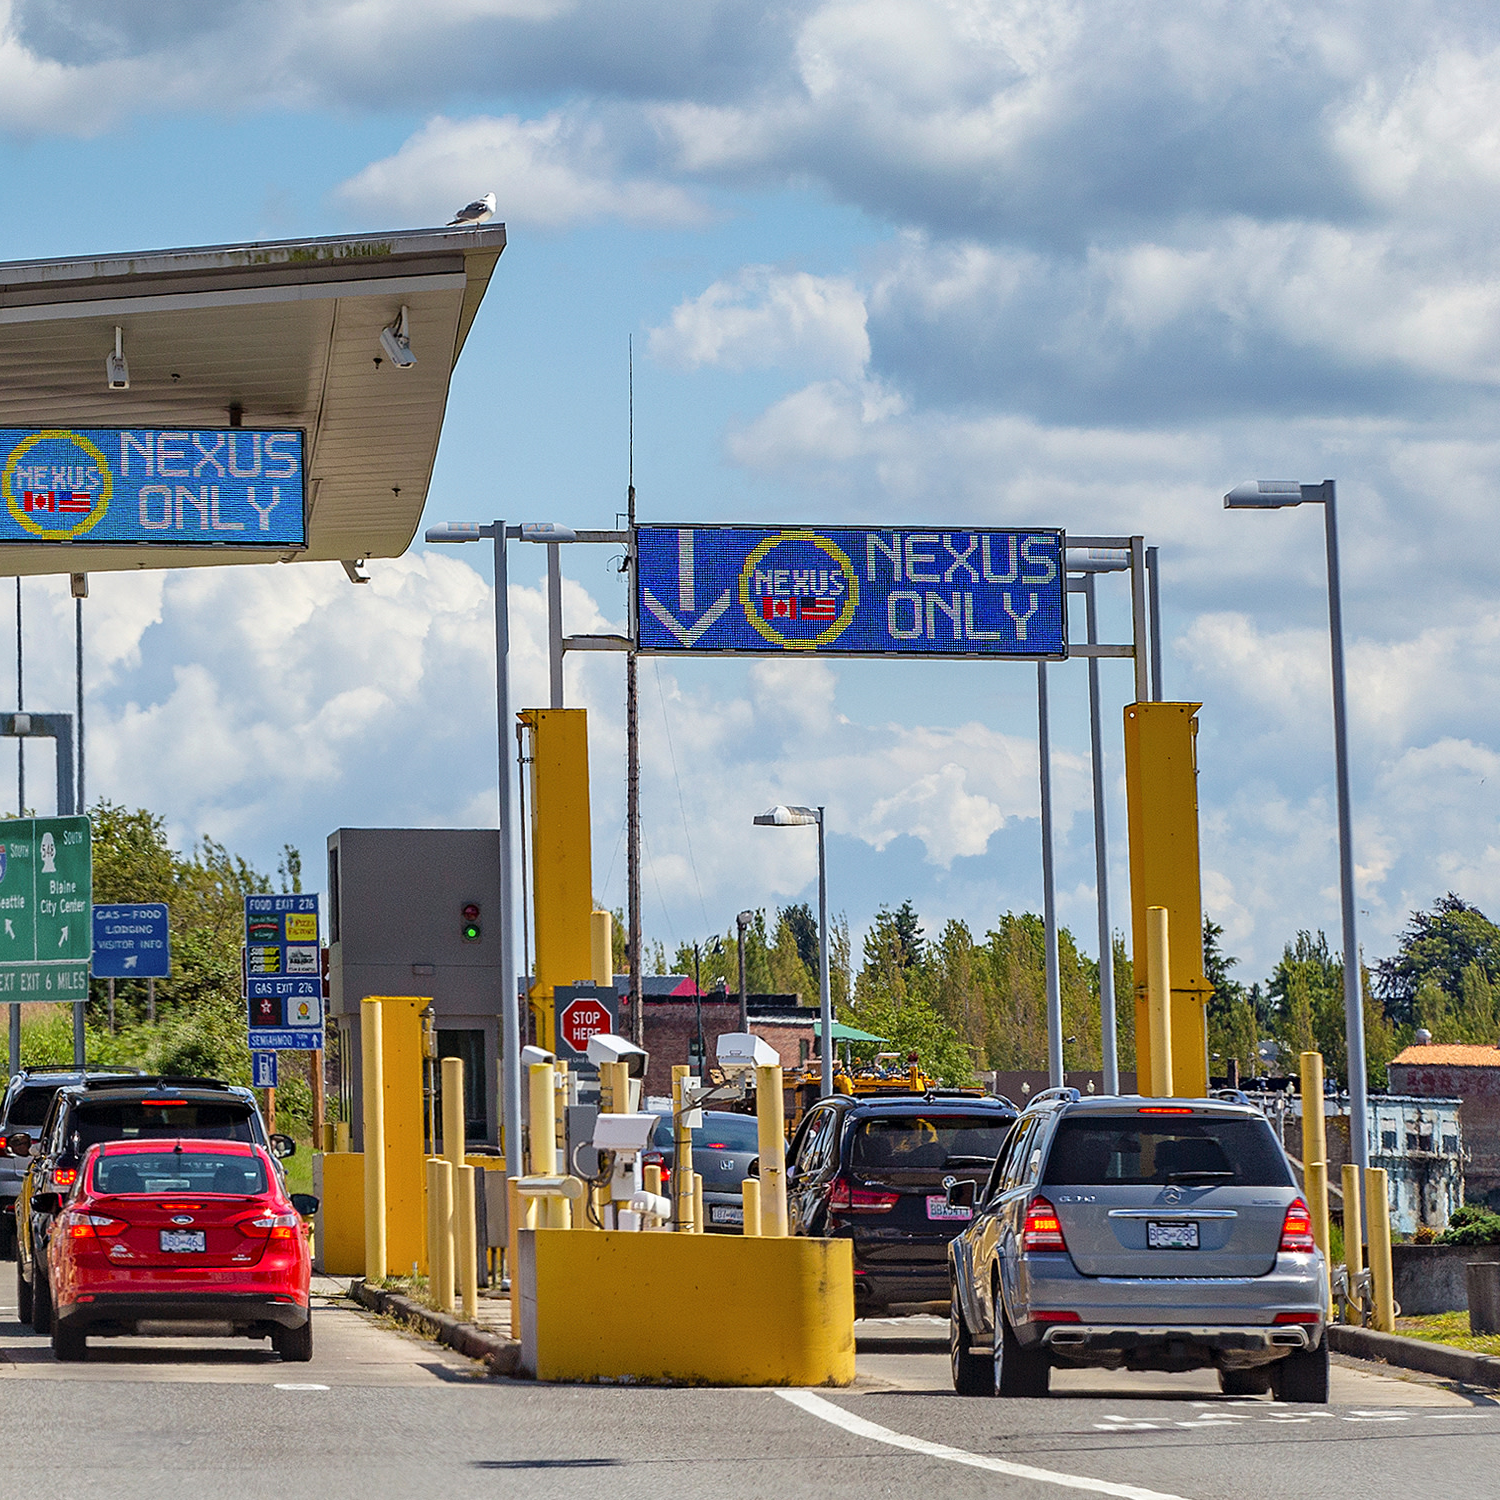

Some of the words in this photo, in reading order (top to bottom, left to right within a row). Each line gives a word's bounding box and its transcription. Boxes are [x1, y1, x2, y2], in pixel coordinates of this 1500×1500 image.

[121, 432, 298, 478] NEXUS
[17, 465, 100, 491] NEXUS
[138, 484, 281, 531] ONLY
[866, 534, 1057, 584] NEXUS
[755, 569, 846, 596] NEXUS
[887, 590, 1039, 640] ONLY
[50, 880, 76, 894] Blaine
[40, 899, 57, 917] City
[60, 898, 86, 913] Center
[249, 899, 271, 910] FOOD
[275, 899, 294, 910] EXIT
[299, 898, 315, 910] 276
[96, 910, 120, 920] GAS
[132, 910, 162, 919] FOOD
[105, 925, 153, 935] LODGING
[97, 940, 134, 949] VISITOR
[141, 940, 163, 949] INFO
[21, 973, 41, 991] EXIT
[45, 973, 52, 990] 6
[57, 972, 85, 990] MILES
[255, 983, 272, 994] GAS
[277, 983, 294, 993] EXIT
[299, 982, 313, 993] 276
[572, 1011, 601, 1025] STOP
